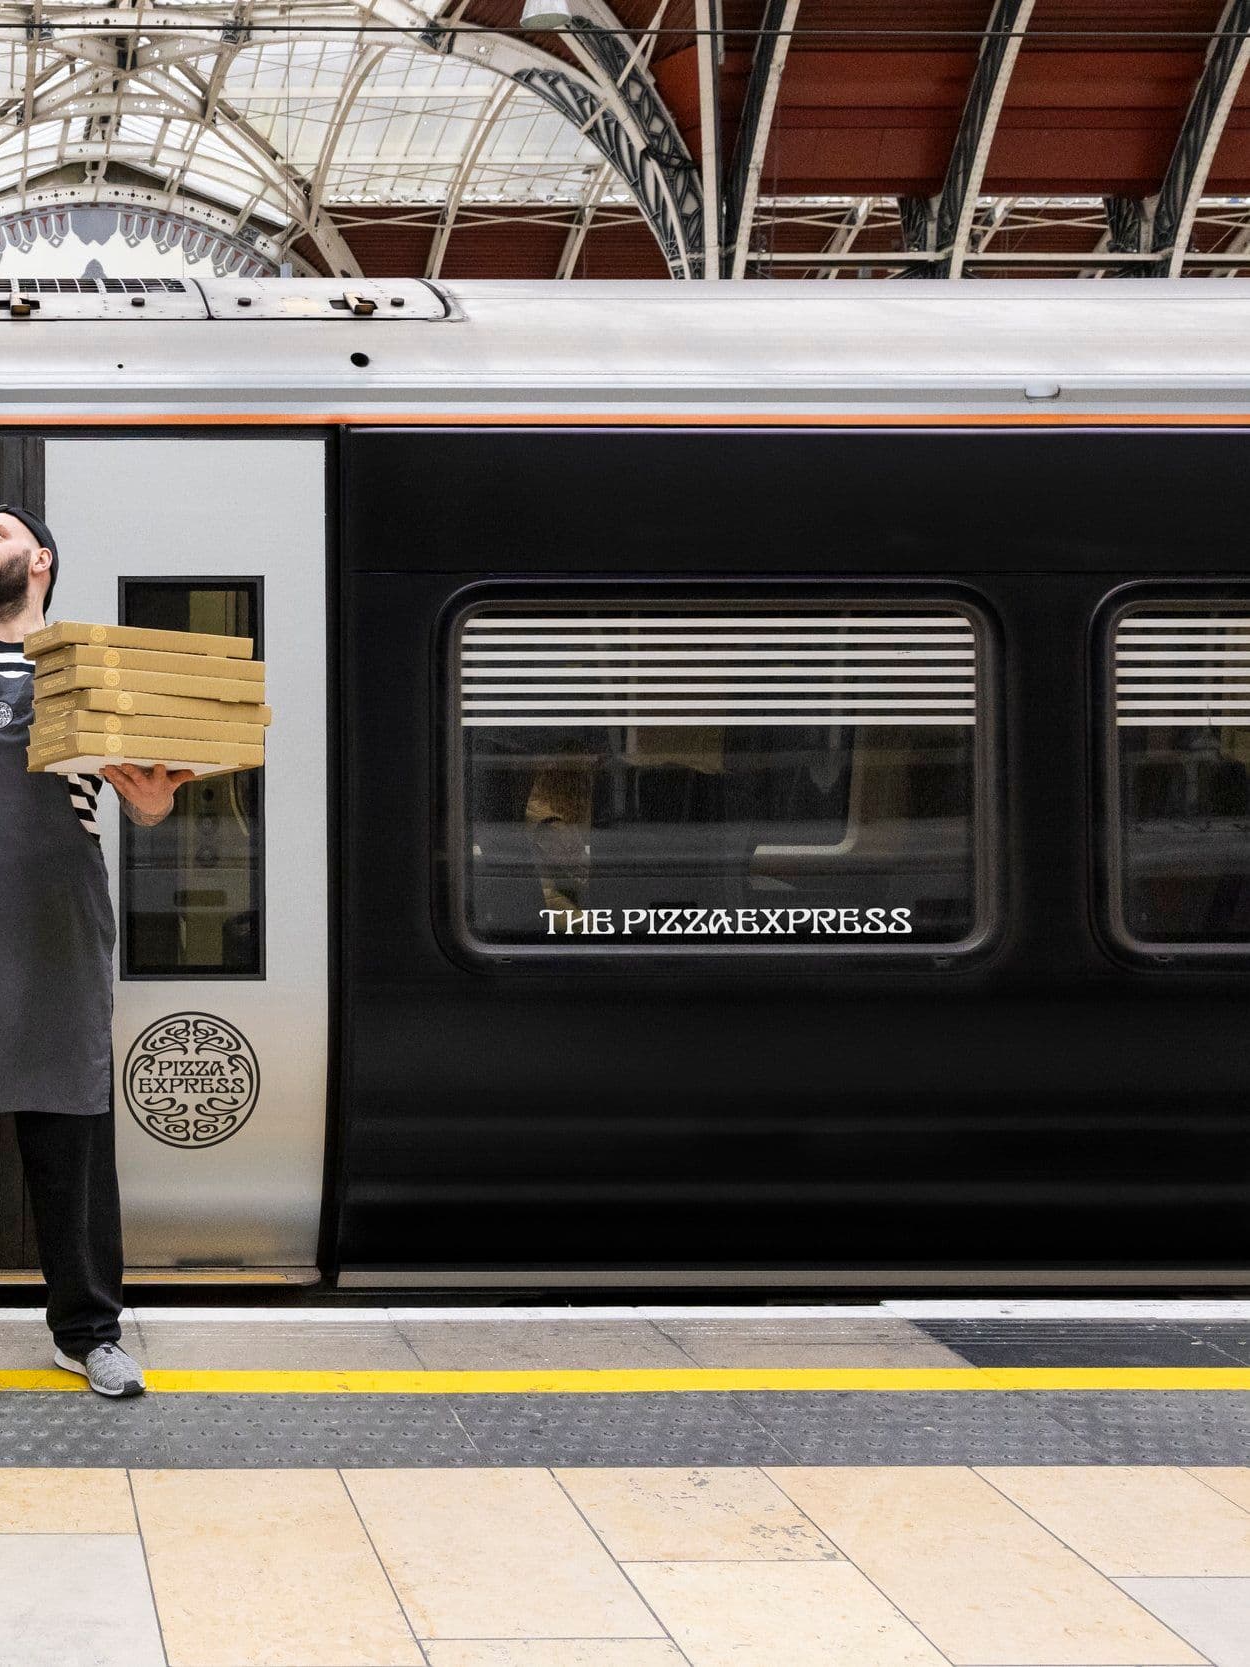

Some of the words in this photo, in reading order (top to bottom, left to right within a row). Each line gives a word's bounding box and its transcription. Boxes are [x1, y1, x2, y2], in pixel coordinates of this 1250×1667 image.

[539, 909, 615, 935] THE
[621, 908, 913, 935] PIZZAEXPRESS
[157, 1060, 226, 1077] PIZZA
[137, 1077, 246, 1094] EXPRESS
